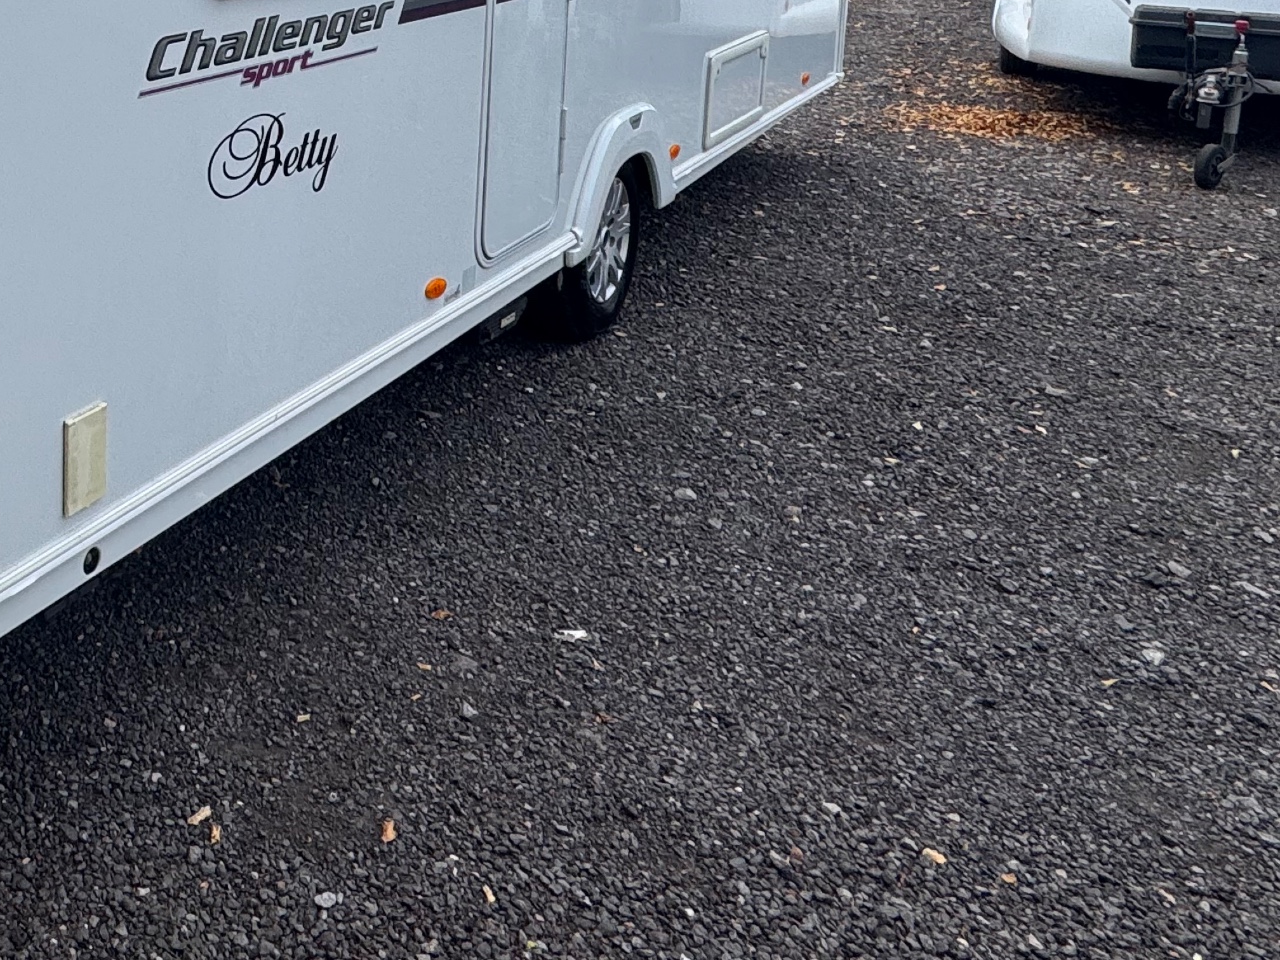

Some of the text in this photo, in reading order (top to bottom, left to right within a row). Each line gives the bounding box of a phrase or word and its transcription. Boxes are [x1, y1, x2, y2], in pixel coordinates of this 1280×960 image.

[146, 0, 395, 82] Challenger
[240, 49, 314, 88] sport
[208, 112, 339, 199] Betty
